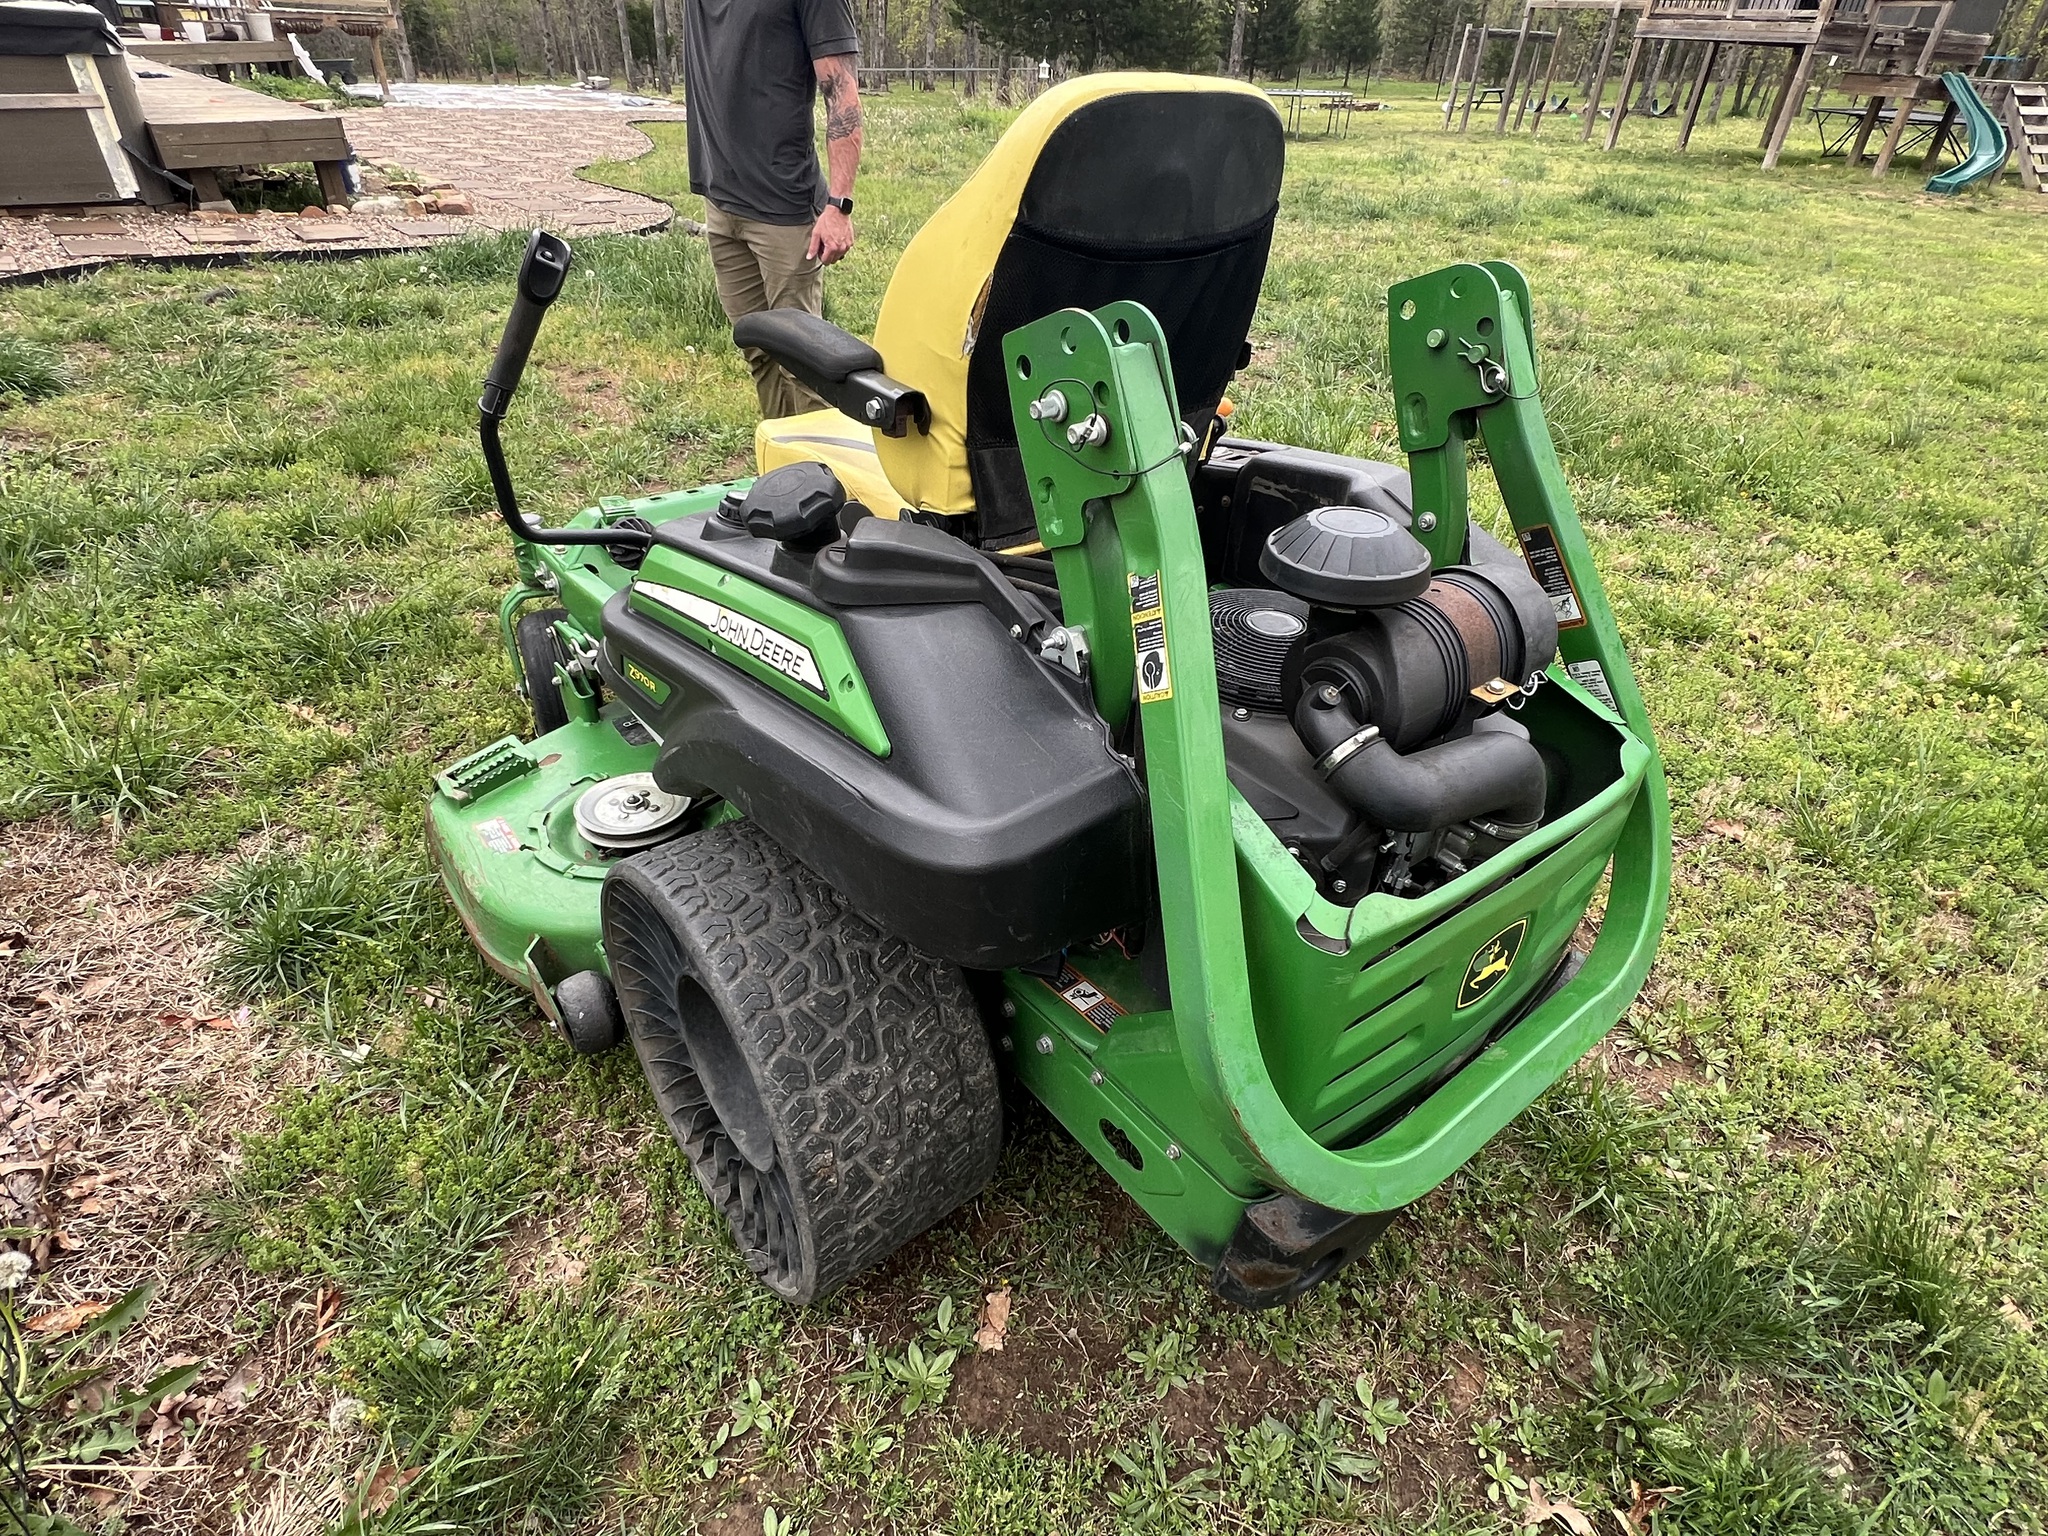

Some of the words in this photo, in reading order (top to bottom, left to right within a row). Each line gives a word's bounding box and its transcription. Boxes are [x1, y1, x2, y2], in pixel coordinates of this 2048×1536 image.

[710, 608, 749, 645] JOHN
[750, 627, 805, 676] DEERE
[628, 663, 657, 693] Z970R
